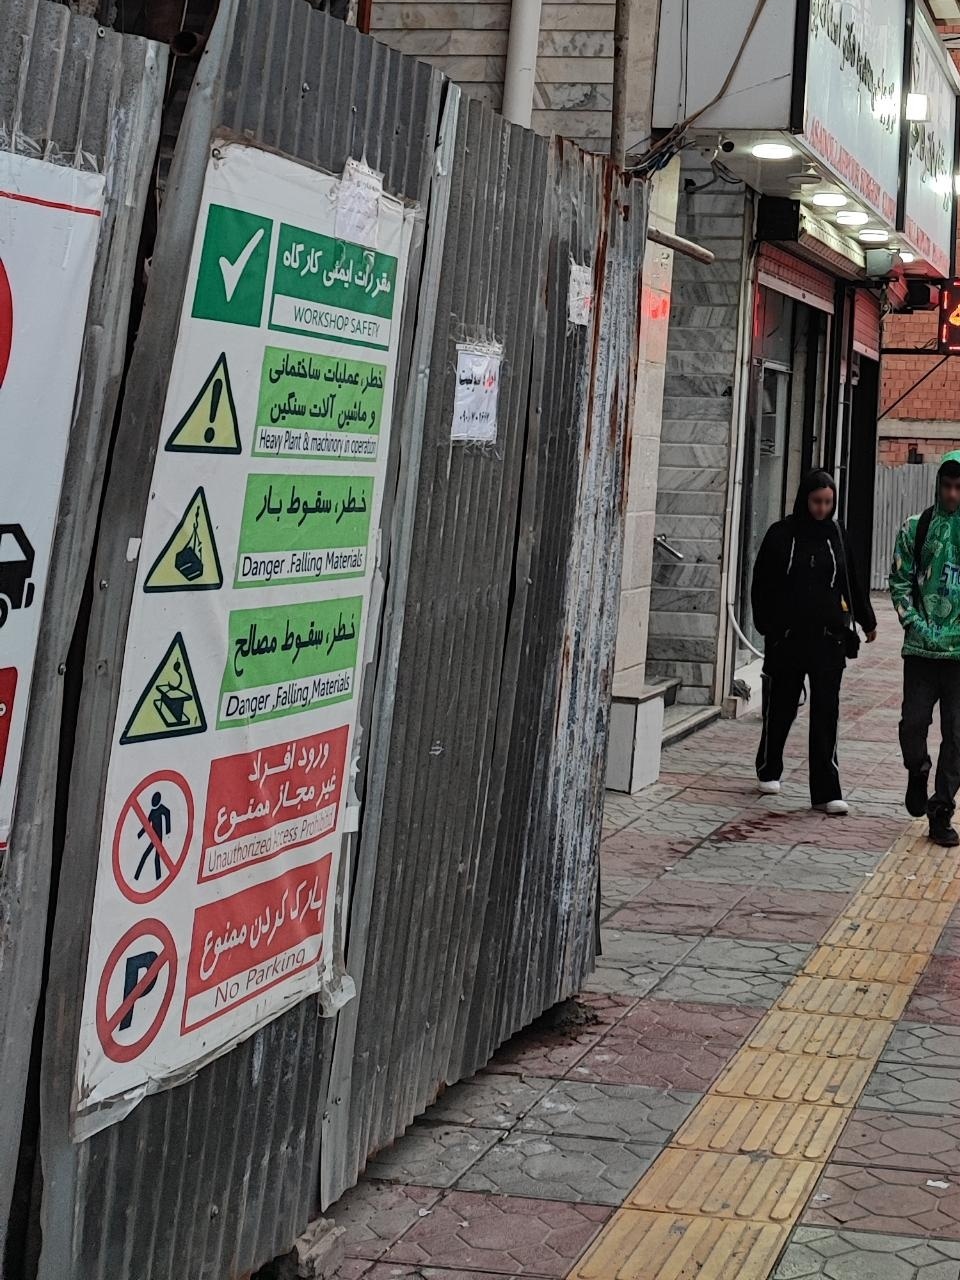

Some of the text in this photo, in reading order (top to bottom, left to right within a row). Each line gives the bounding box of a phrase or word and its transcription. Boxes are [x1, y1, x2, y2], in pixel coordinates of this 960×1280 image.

[283, 243, 323, 276] کارگاه
[323, 259, 354, 288] ایمنی
[294, 305, 381, 338] WORKSHOP SAFETY
[269, 353, 321, 384] ساختمانی
[324, 361, 359, 388] عملیات
[270, 391, 376, 429] و ماشین آلات سنگین
[259, 429, 283, 455] Heavy
[283, 430, 302, 451] Plant
[303, 431, 310, 451] &
[344, 434, 350, 453] in
[256, 484, 282, 521] بار
[287, 485, 332, 526] سقوط
[242, 551, 363, 582] Danger Materials
[234, 623, 277, 678] مصالح
[281, 619, 323, 664] سقوط
[226, 693, 270, 718] Danger
[248, 741, 330, 787] ورود افراد
[214, 768, 336, 842] غیر مجاز ممنوع
[208, 835, 273, 872] Unauthorized
[200, 875, 324, 981] پارک کردن ممنوع
[214, 946, 306, 1007] No Parking
